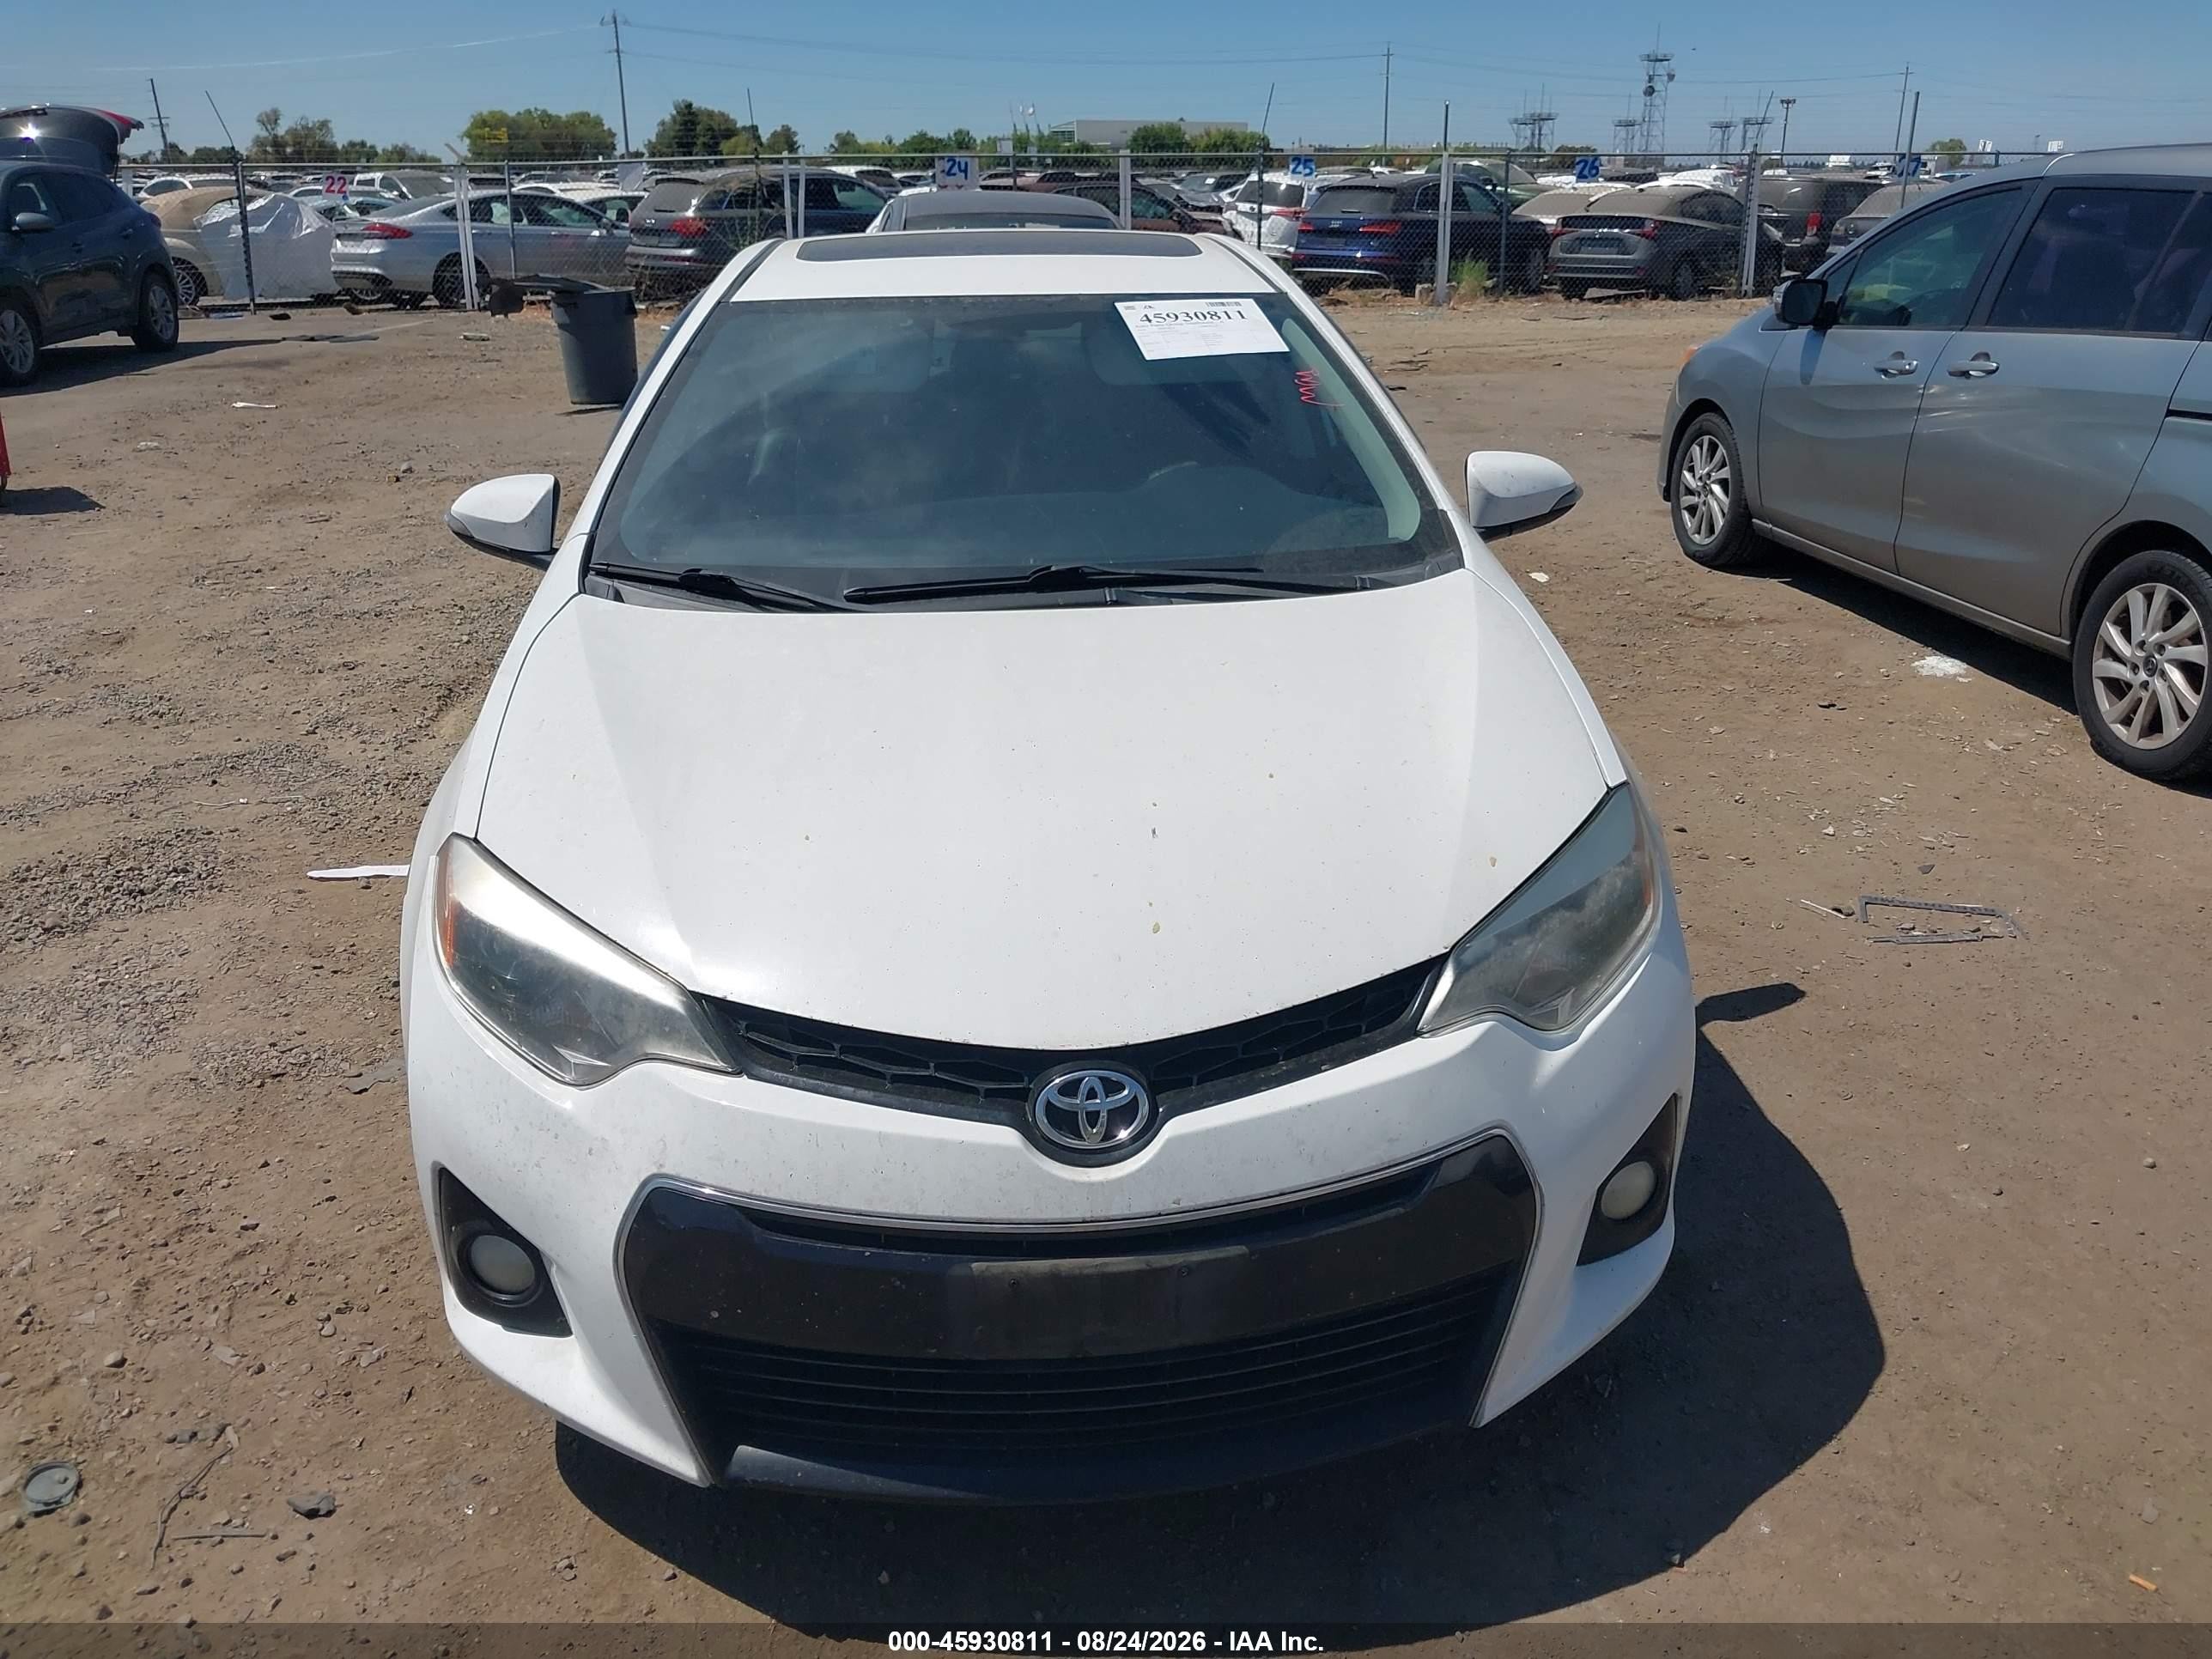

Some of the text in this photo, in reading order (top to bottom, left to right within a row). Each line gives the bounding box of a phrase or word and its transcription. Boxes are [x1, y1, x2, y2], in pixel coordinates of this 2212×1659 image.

[946, 158, 969, 180] 24
[1291, 158, 1314, 176] 25
[1576, 158, 1600, 179] 26
[325, 175, 347, 194] 22
[1139, 310, 1247, 324] 45930811
